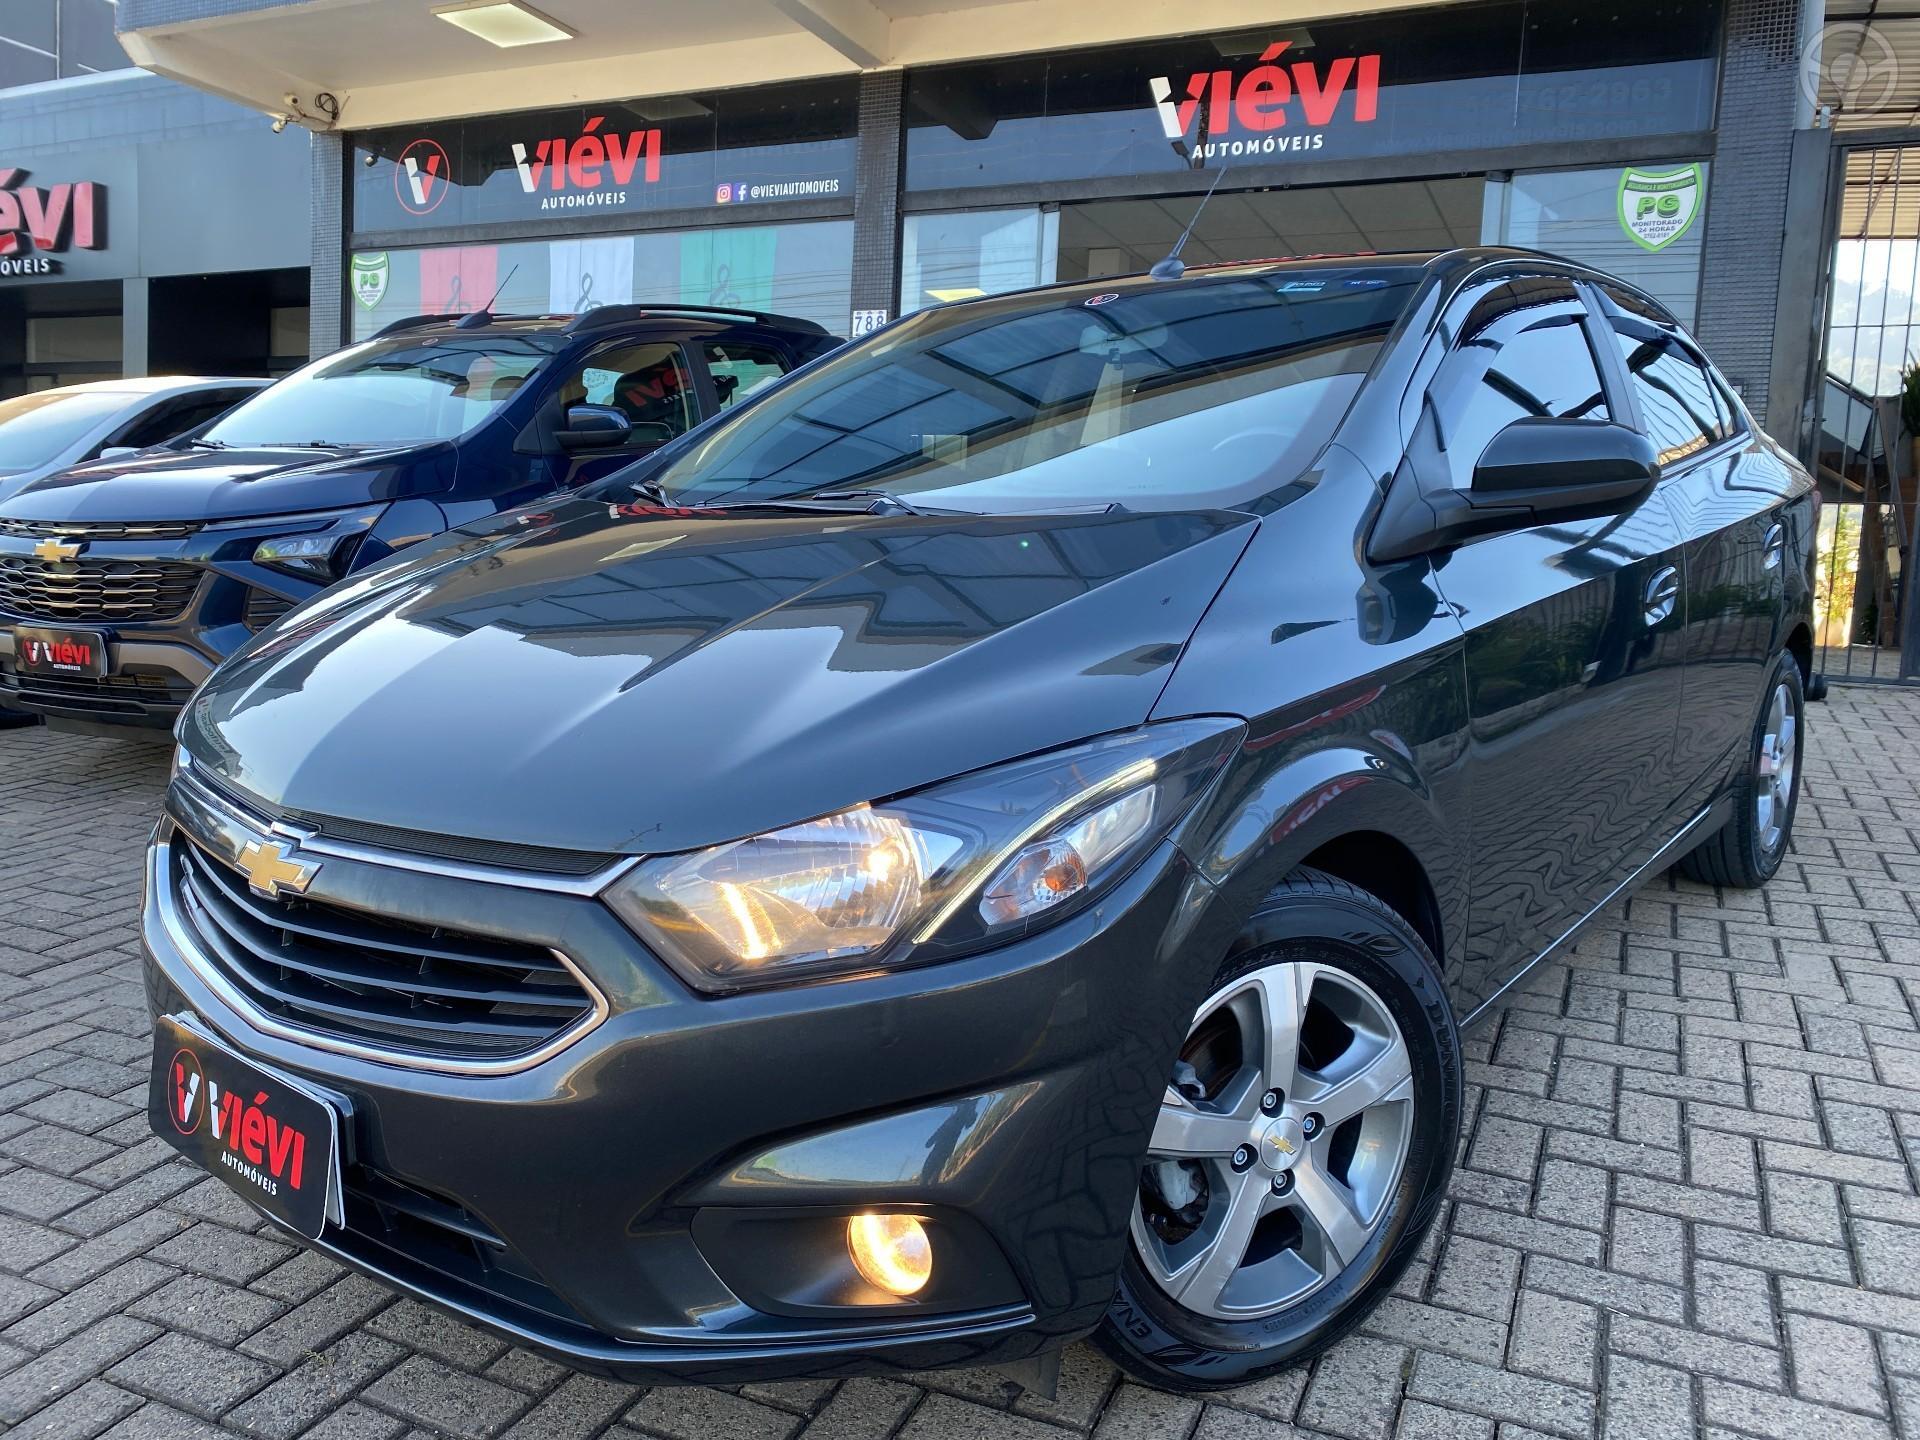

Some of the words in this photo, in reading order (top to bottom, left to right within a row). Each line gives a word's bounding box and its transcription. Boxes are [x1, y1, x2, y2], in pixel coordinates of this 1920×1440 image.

[1192, 134, 1324, 159] AUTOMÓVEIS
[750, 179, 839, 198] @VIEVIAUTOMOVEIS
[541, 191, 627, 209] AUTOMÓVEIS
[1637, 195, 1680, 220] PG
[1632, 218, 1683, 228] MONITORADO
[1638, 226, 1648, 234] 24
[1649, 225, 1676, 233] HORAS
[360, 272, 380, 290] PG
[854, 315, 884, 332] 788
[221, 1150, 278, 1196] AUTOMÓVEIS
